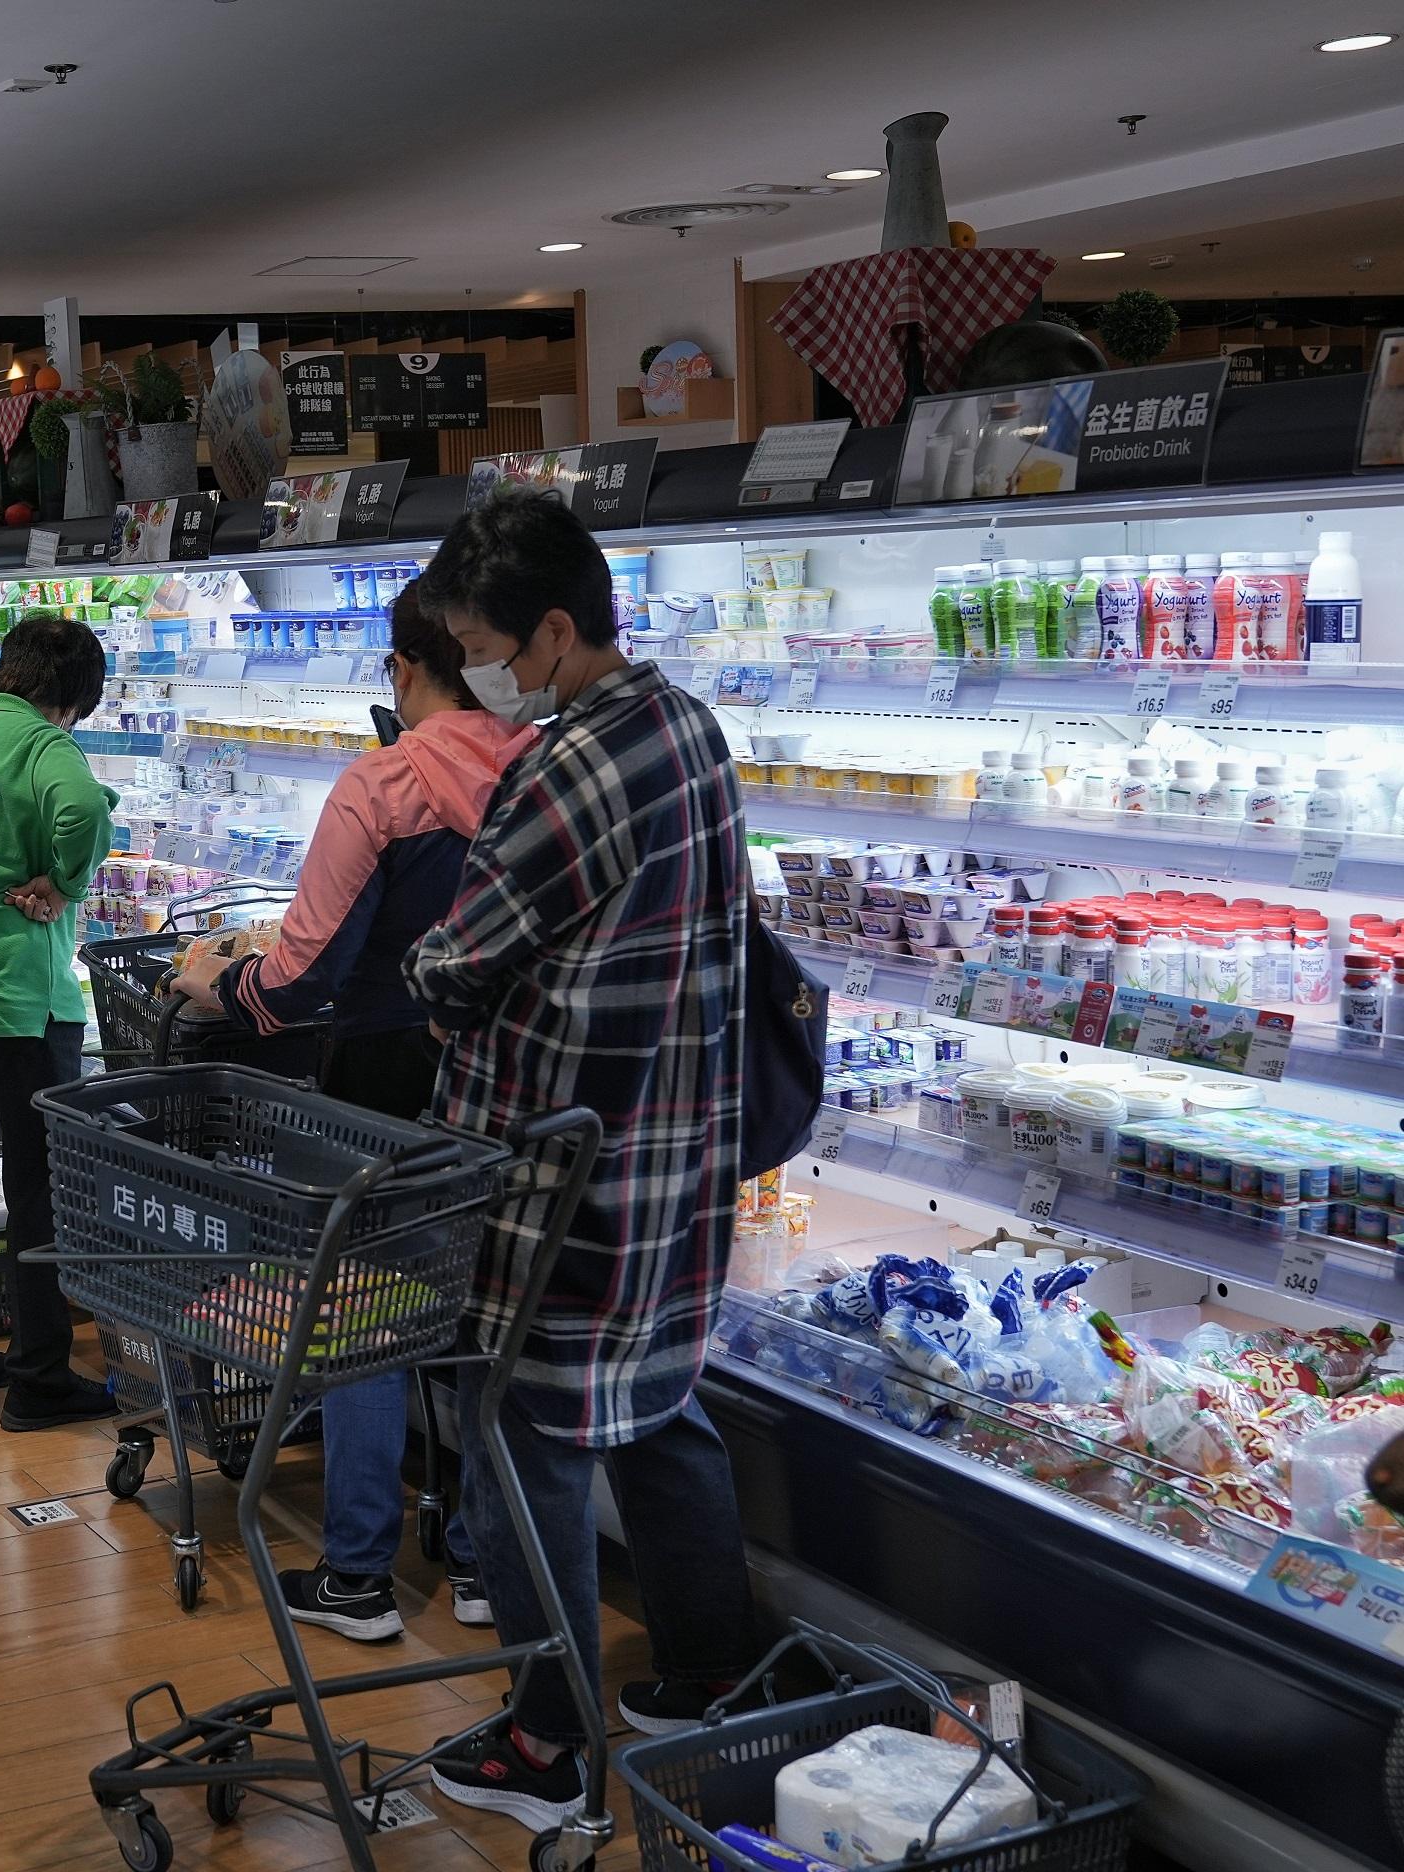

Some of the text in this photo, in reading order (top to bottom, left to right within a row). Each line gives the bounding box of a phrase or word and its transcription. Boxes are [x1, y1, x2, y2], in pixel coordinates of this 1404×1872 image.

[1309, 347, 1322, 360] 7
[409, 354, 429, 370] 9
[298, 365, 331, 379] 此行為
[285, 383, 345, 396] 5-6號收銀機
[299, 399, 332, 412] 排隊線
[1084, 391, 1210, 438] 益生菌飲品
[1088, 437, 1192, 464] Probiotic Drink
[594, 462, 627, 491] 乳酪
[592, 496, 619, 512] Yogurt
[354, 510, 375, 525] Yogurt
[1154, 592, 1187, 611] Yogur
[930, 689, 953, 702] $18.5
[1136, 698, 1164, 713] $16.5
[1210, 699, 1233, 714] $95
[846, 982, 868, 997] $21.9
[934, 993, 959, 1009] $21.9
[821, 1145, 839, 1159] $55
[1029, 1200, 1052, 1217] $65
[112, 1184, 228, 1253] 店內專用
[1284, 1273, 1318, 1295] $34.9
